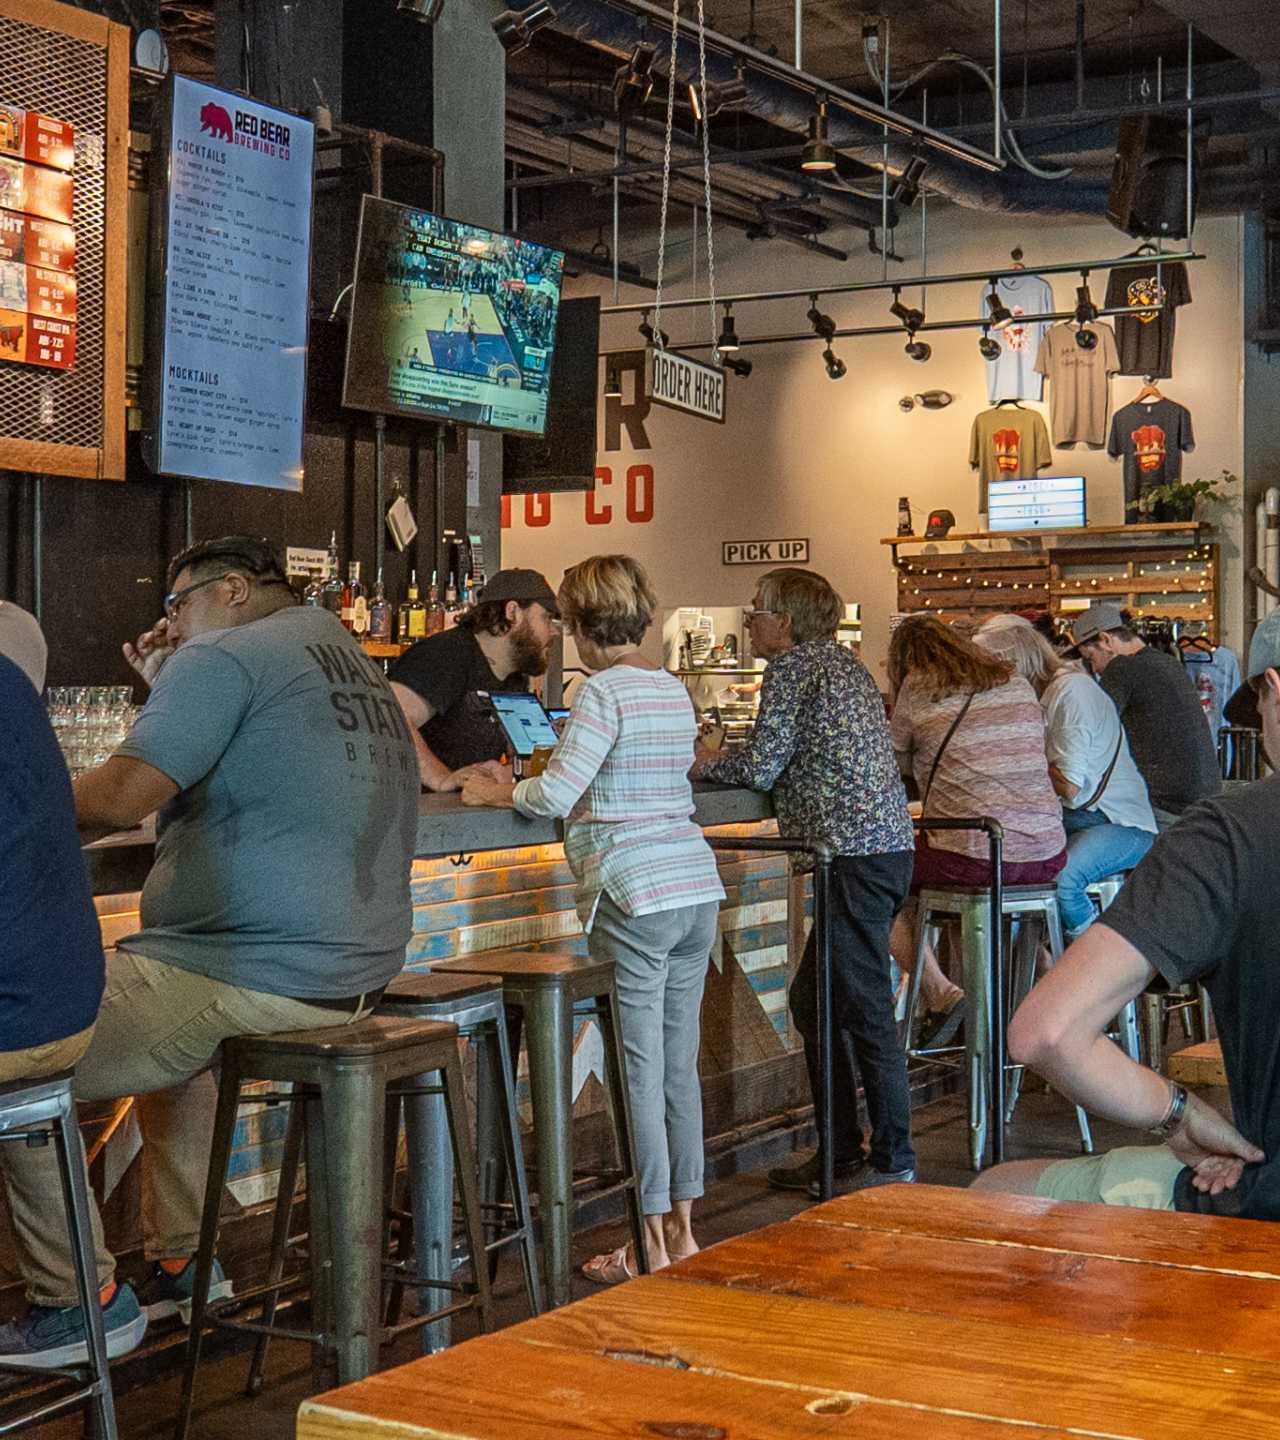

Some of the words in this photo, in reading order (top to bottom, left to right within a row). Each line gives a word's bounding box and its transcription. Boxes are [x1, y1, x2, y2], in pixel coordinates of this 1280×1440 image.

[234, 110, 258, 135] RED
[260, 118, 291, 148] BEAR
[176, 138, 227, 165] COCKTAILS
[234, 133, 276, 157] BREWING
[278, 148, 291, 161] CO
[169, 365, 220, 386] MOCKTAILS
[653, 353, 692, 404] ORDER
[694, 369, 722, 416] HERE
[585, 464, 654, 525] CO
[727, 543, 773, 562] PICK
[778, 542, 805, 561] UP
